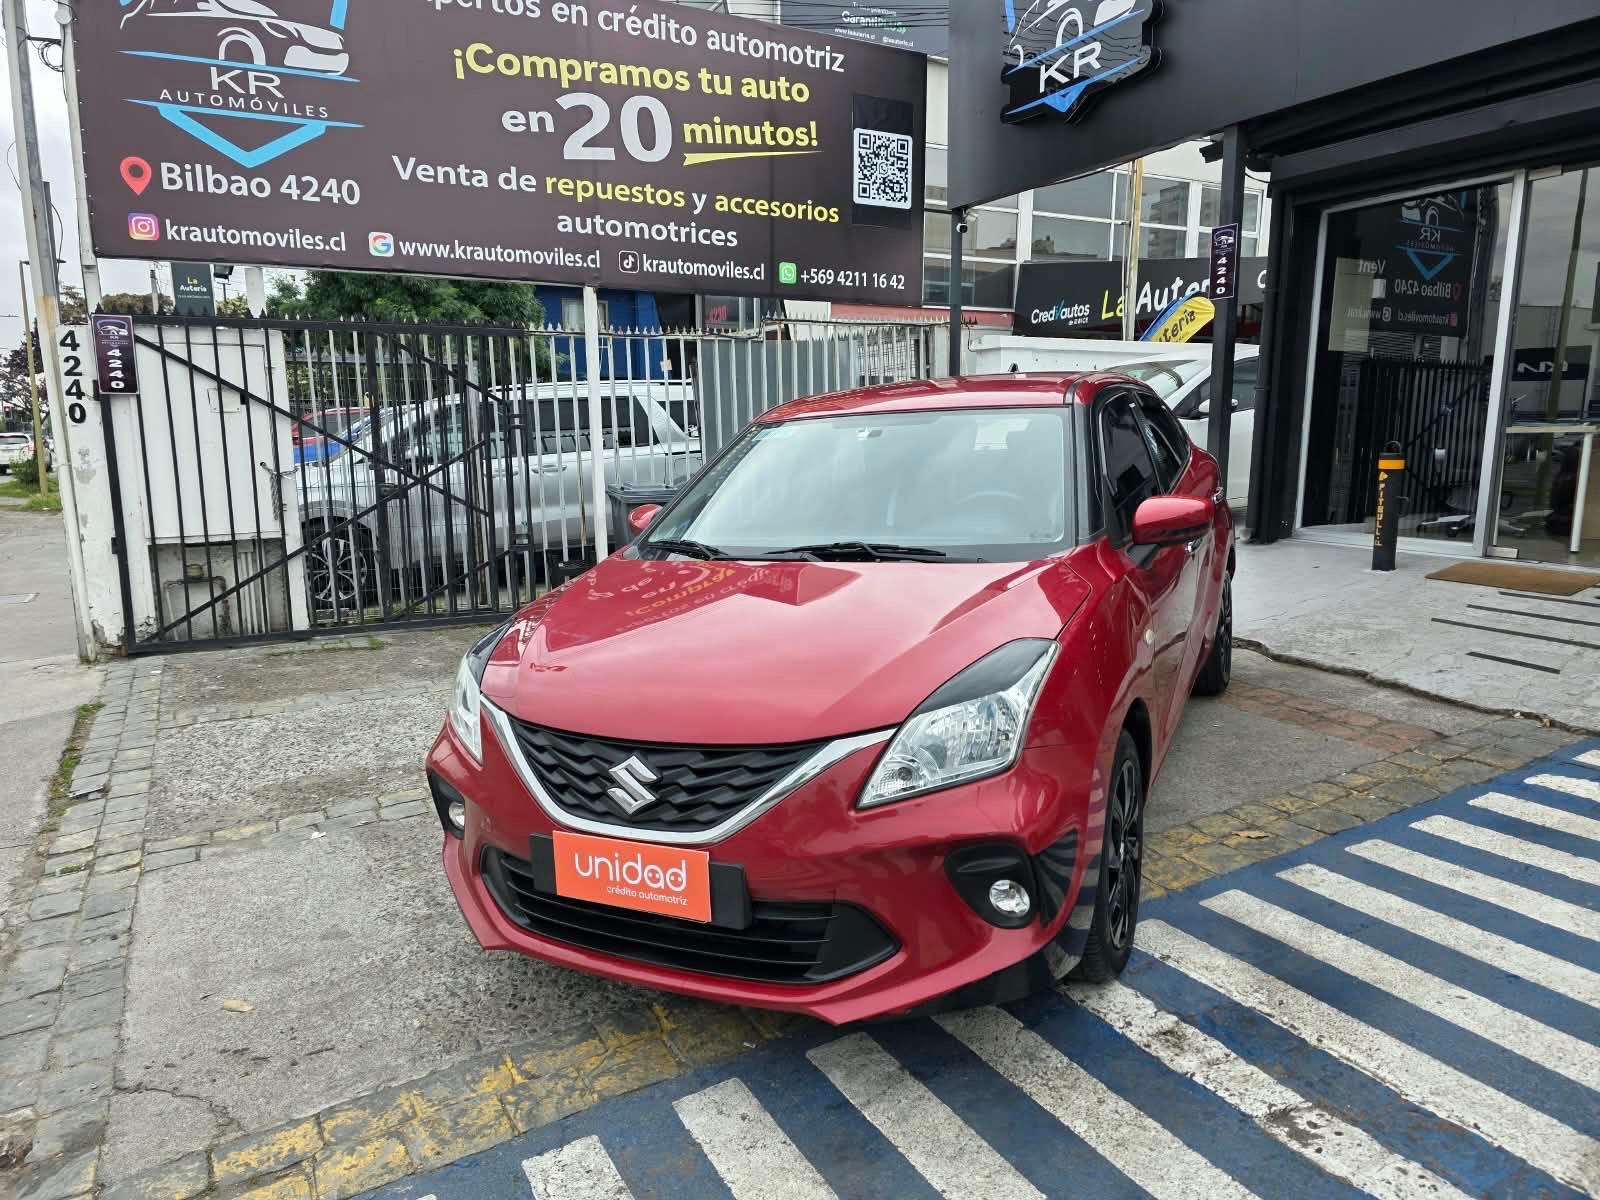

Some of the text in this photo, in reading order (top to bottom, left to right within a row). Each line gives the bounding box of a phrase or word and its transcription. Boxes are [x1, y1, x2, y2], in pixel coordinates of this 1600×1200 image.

[551, 1, 588, 27] en
[597, 5, 697, 46] crédito
[706, 29, 845, 73] automotriz
[210, 66, 284, 98] KR
[453, 43, 810, 103] ¡Compramos tu auto
[1040, 41, 1102, 93] KR
[159, 89, 329, 118] AUTOMÓVILES
[501, 92, 819, 163] en 20 minutos!
[160, 162, 361, 205] Bilbao 4240
[392, 155, 840, 223] Venta de repuestos y accesorios
[165, 219, 347, 251] krautomoviles.cl
[556, 212, 739, 247] automotrices
[399, 239, 601, 269] www.krautomoviles.cl
[642, 253, 766, 281] krautomoviles.cl
[801, 268, 905, 290] +569 4211 16 42
[1215, 256, 1228, 295] 4240
[1101, 289, 1125, 321] La
[59, 329, 87, 424] 4240
[107, 348, 125, 389] 4240
[574, 852, 687, 892] unidad
[606, 885, 688, 906] crédito automotriz
